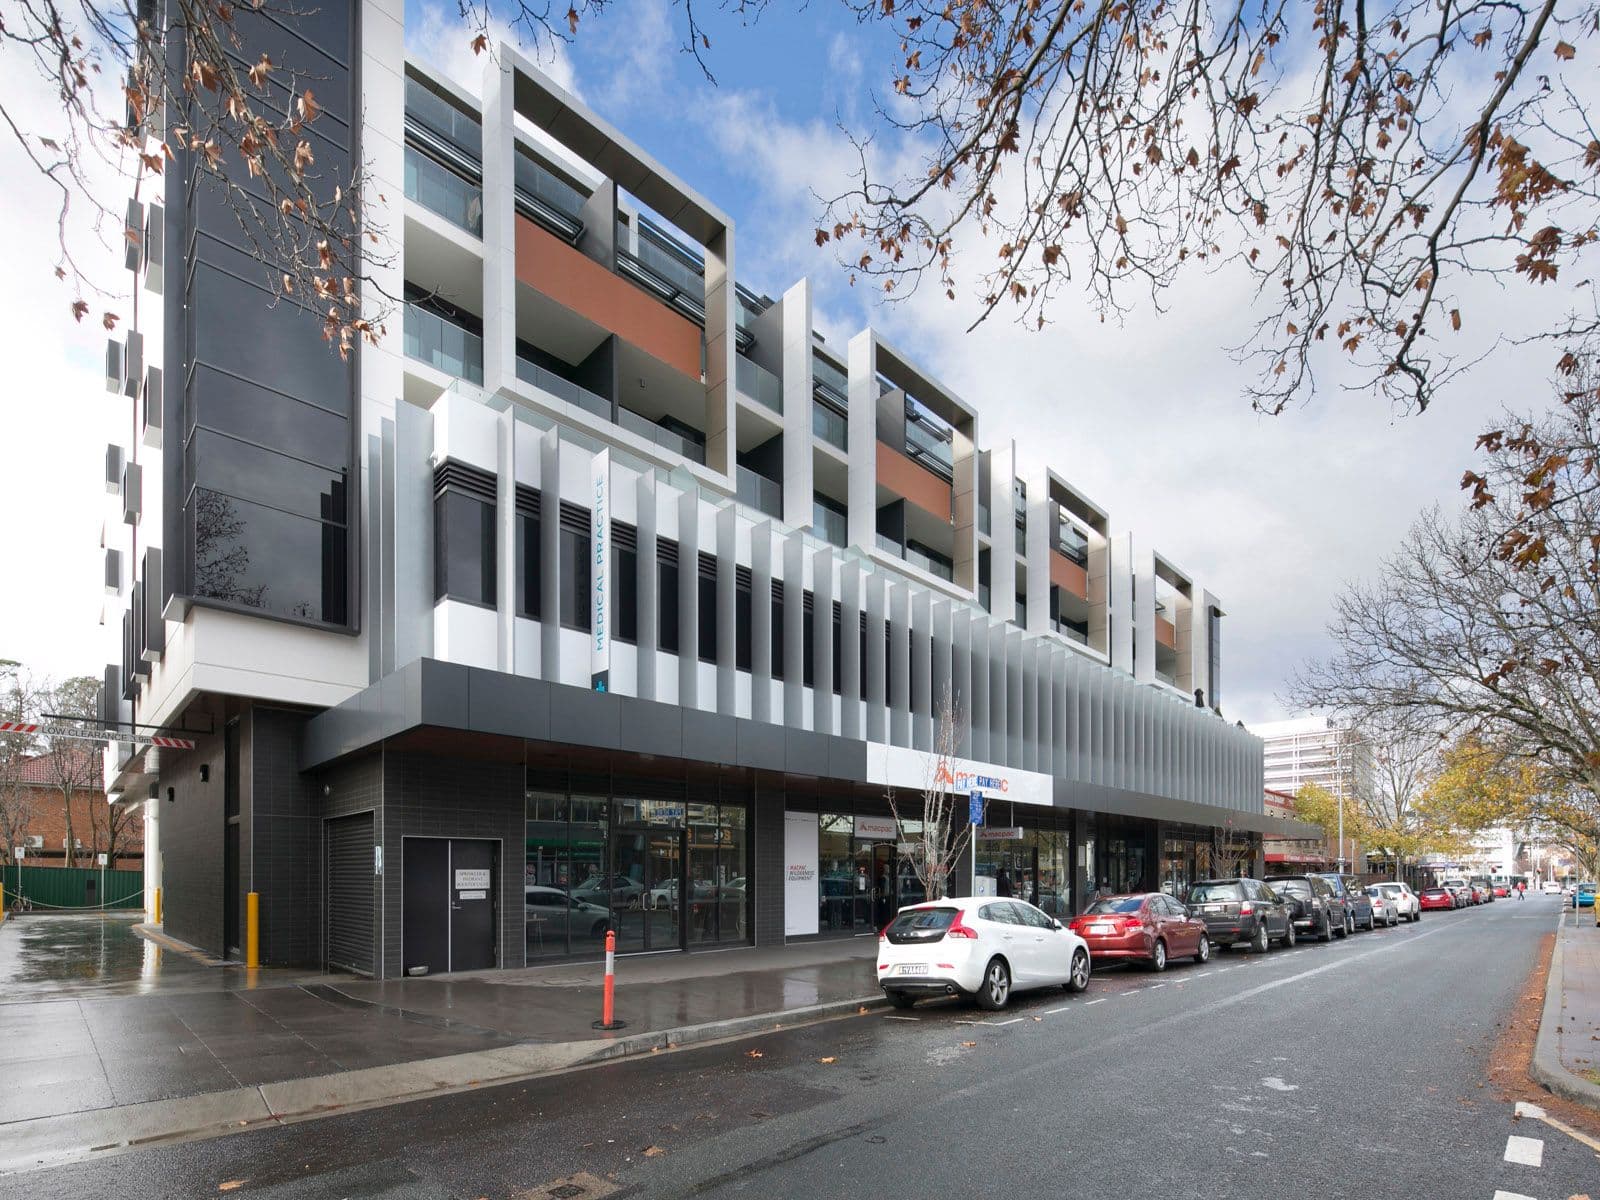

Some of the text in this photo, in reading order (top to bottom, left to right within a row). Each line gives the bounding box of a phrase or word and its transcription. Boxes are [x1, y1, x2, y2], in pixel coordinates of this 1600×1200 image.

[596, 475, 605, 652] MEDICAL PRACTICE
[41, 726, 66, 735] LOW
[69, 729, 128, 742] CLEARANCE
[868, 824, 893, 833] macpac
